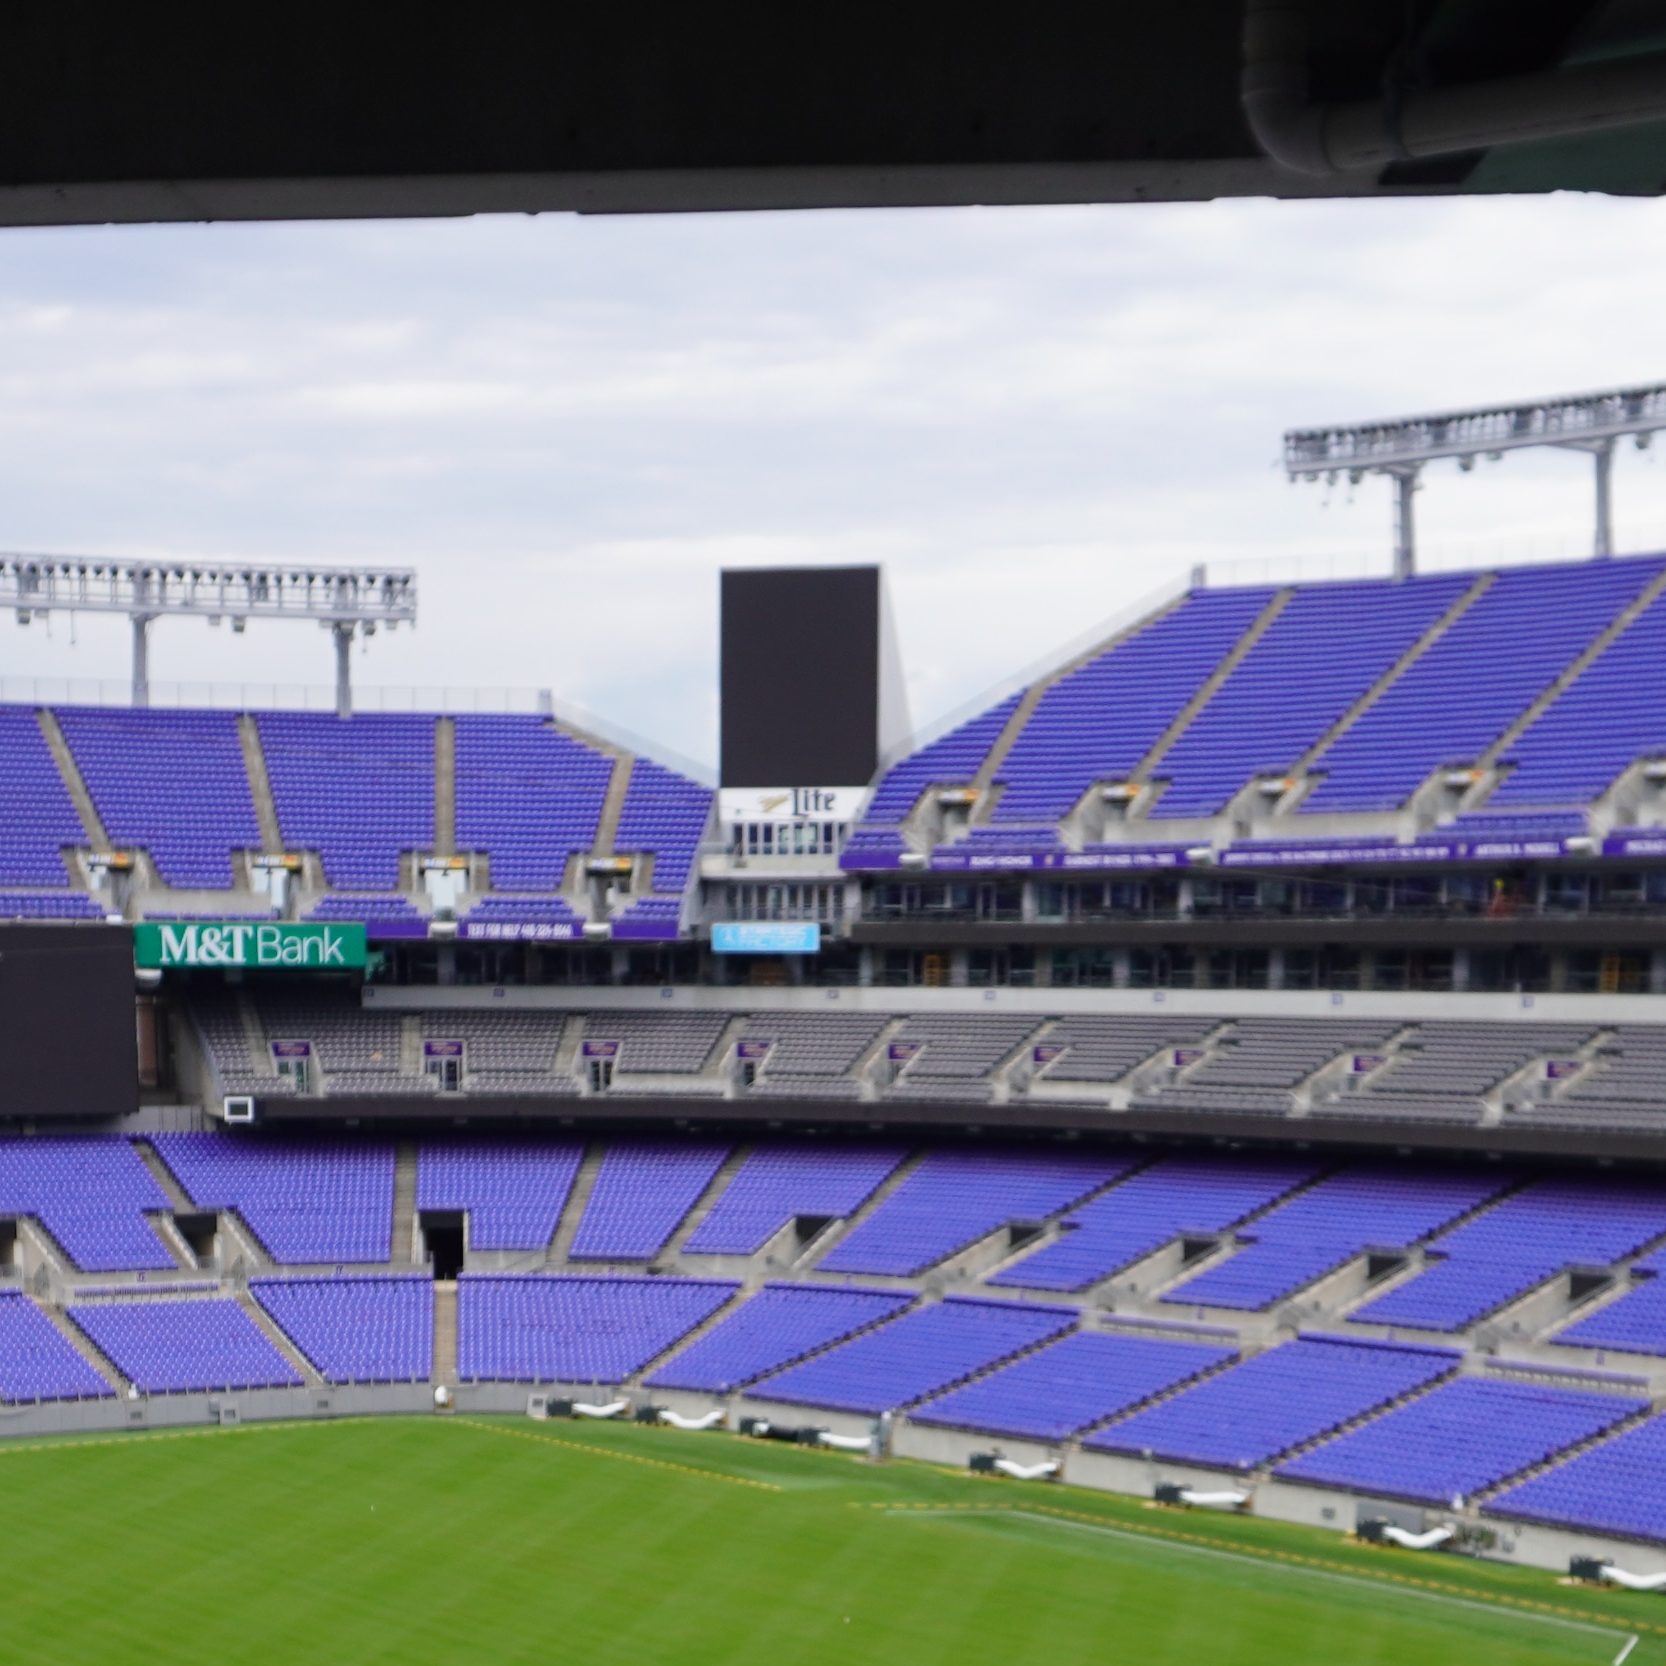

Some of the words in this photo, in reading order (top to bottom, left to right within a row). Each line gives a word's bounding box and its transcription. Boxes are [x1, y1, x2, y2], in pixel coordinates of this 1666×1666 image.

[792, 788, 836, 819] Lite
[157, 924, 254, 964] M&T
[256, 924, 346, 965] Bank
